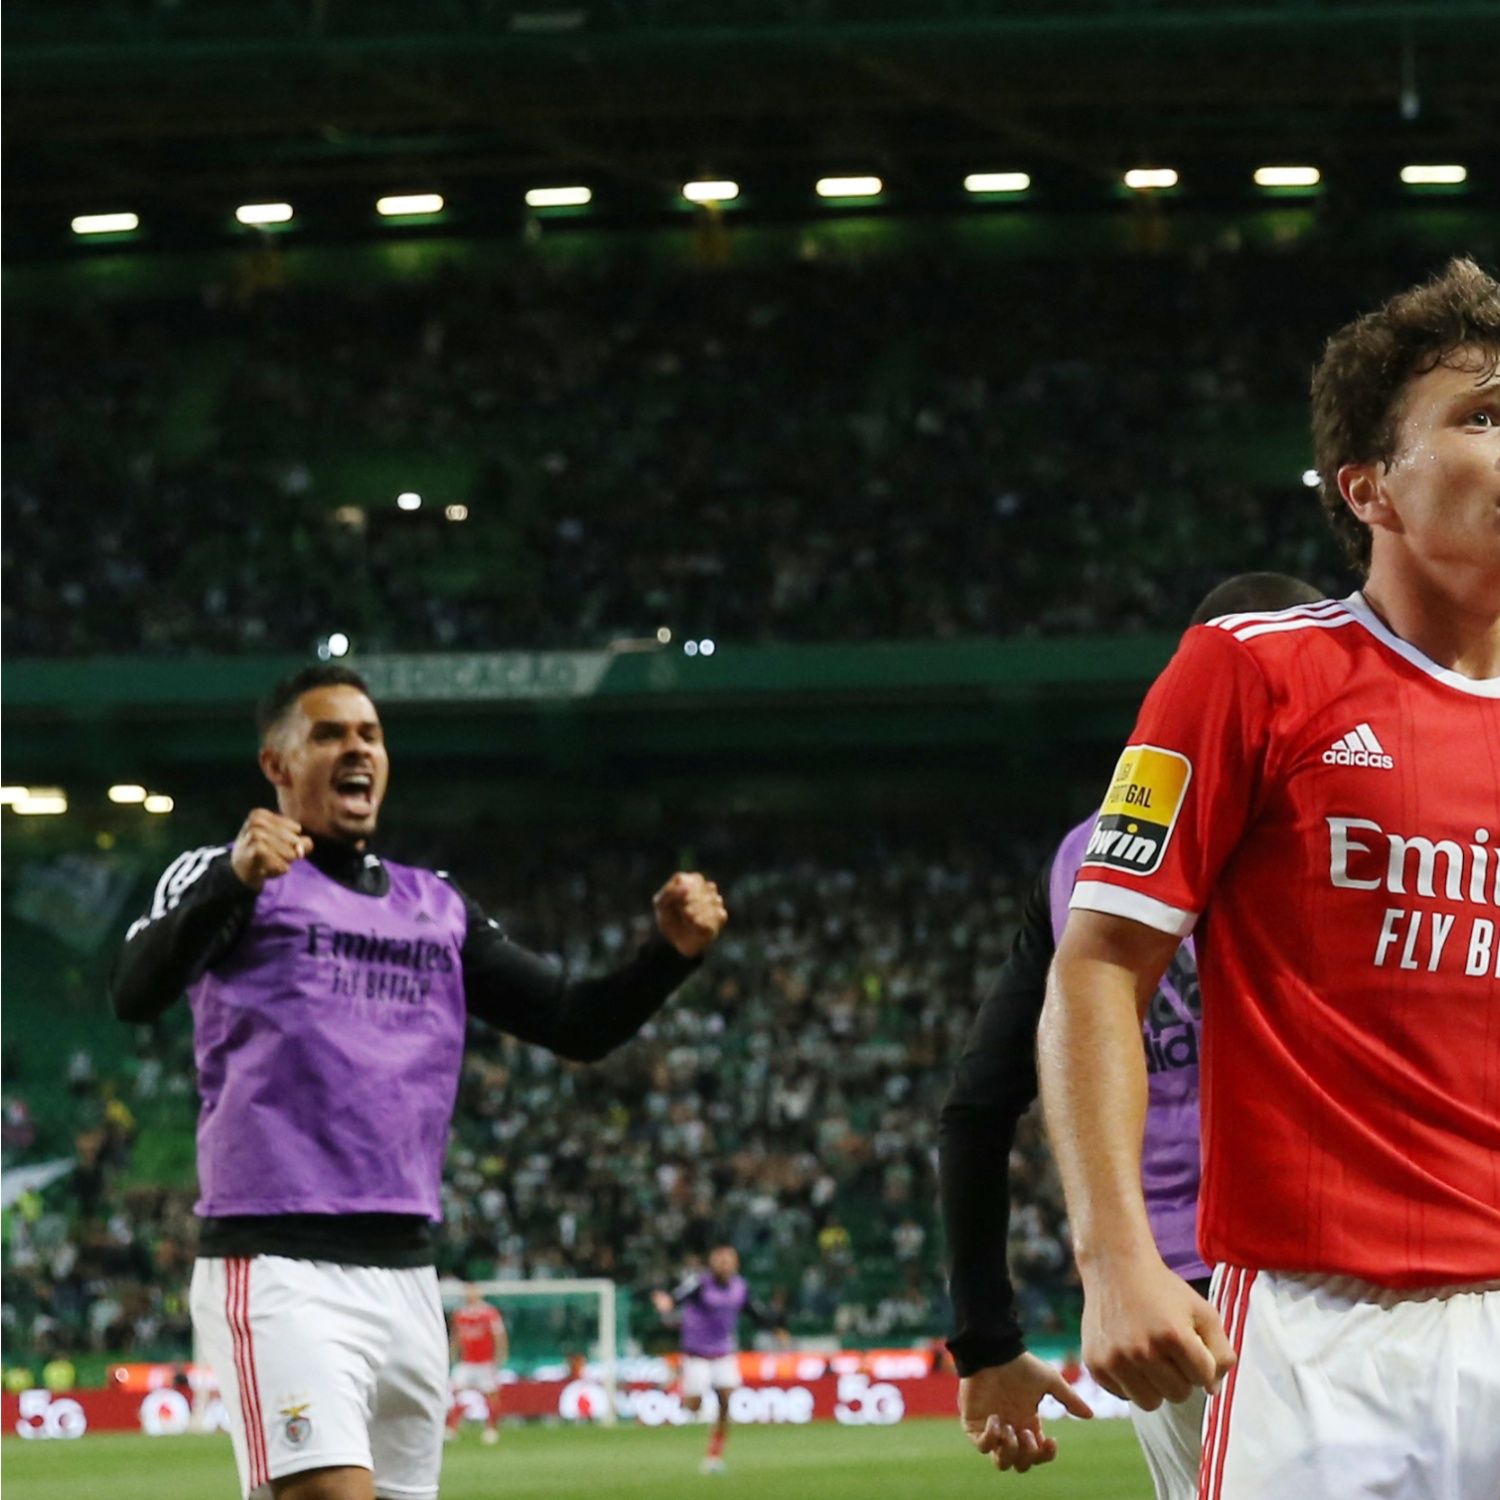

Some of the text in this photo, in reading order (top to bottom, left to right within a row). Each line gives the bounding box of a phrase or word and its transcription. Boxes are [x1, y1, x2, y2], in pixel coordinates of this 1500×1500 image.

[1322, 749, 1394, 770] adidas
[306, 924, 453, 973] Emirates
[1373, 907, 1455, 973] FLY
